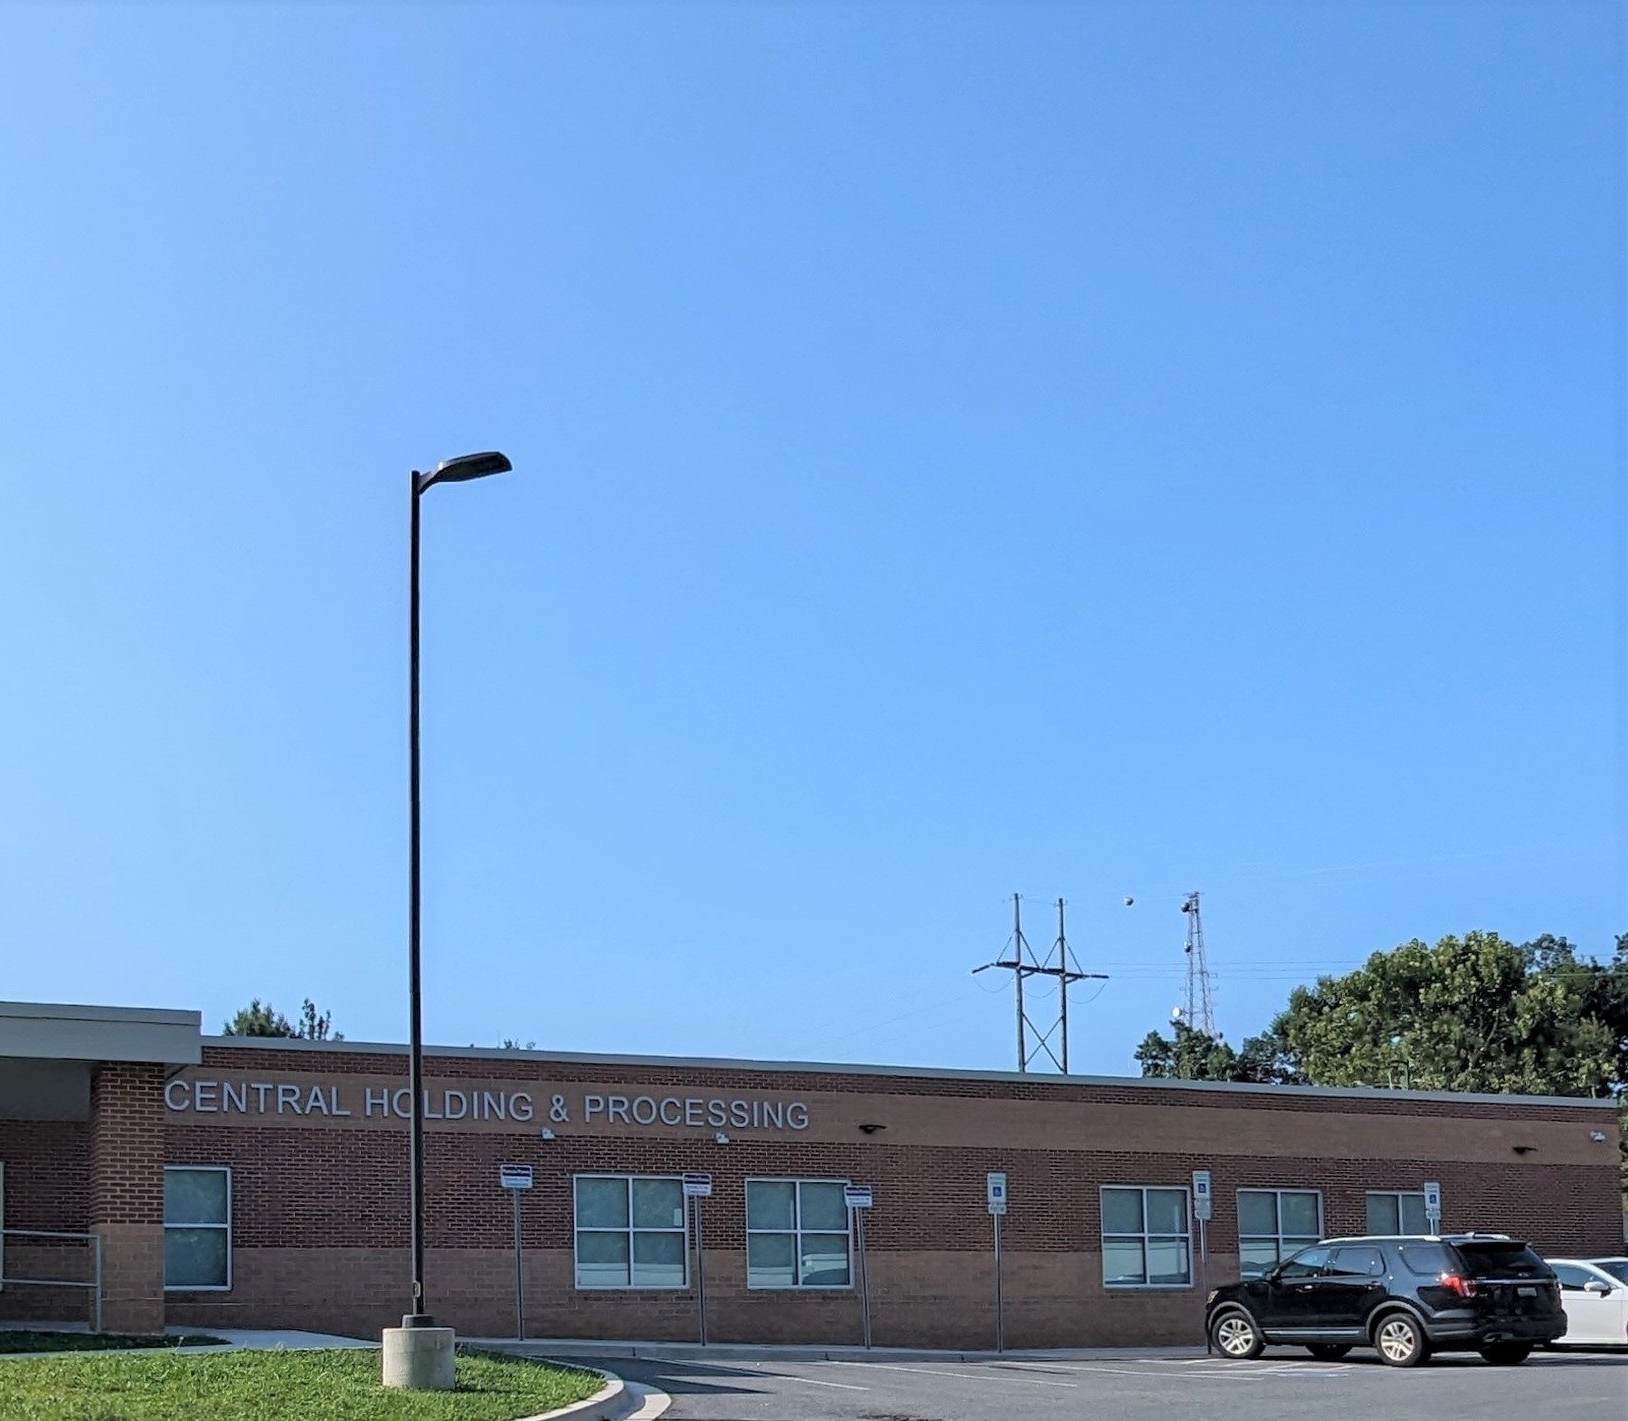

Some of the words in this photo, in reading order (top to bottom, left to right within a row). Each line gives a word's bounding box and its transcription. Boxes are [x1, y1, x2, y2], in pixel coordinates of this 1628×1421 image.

[165, 1080, 351, 1116] CENTRAL
[365, 1088, 533, 1121] HOLDING
[549, 1094, 570, 1122] &
[584, 1095, 808, 1129] PROCESSING
